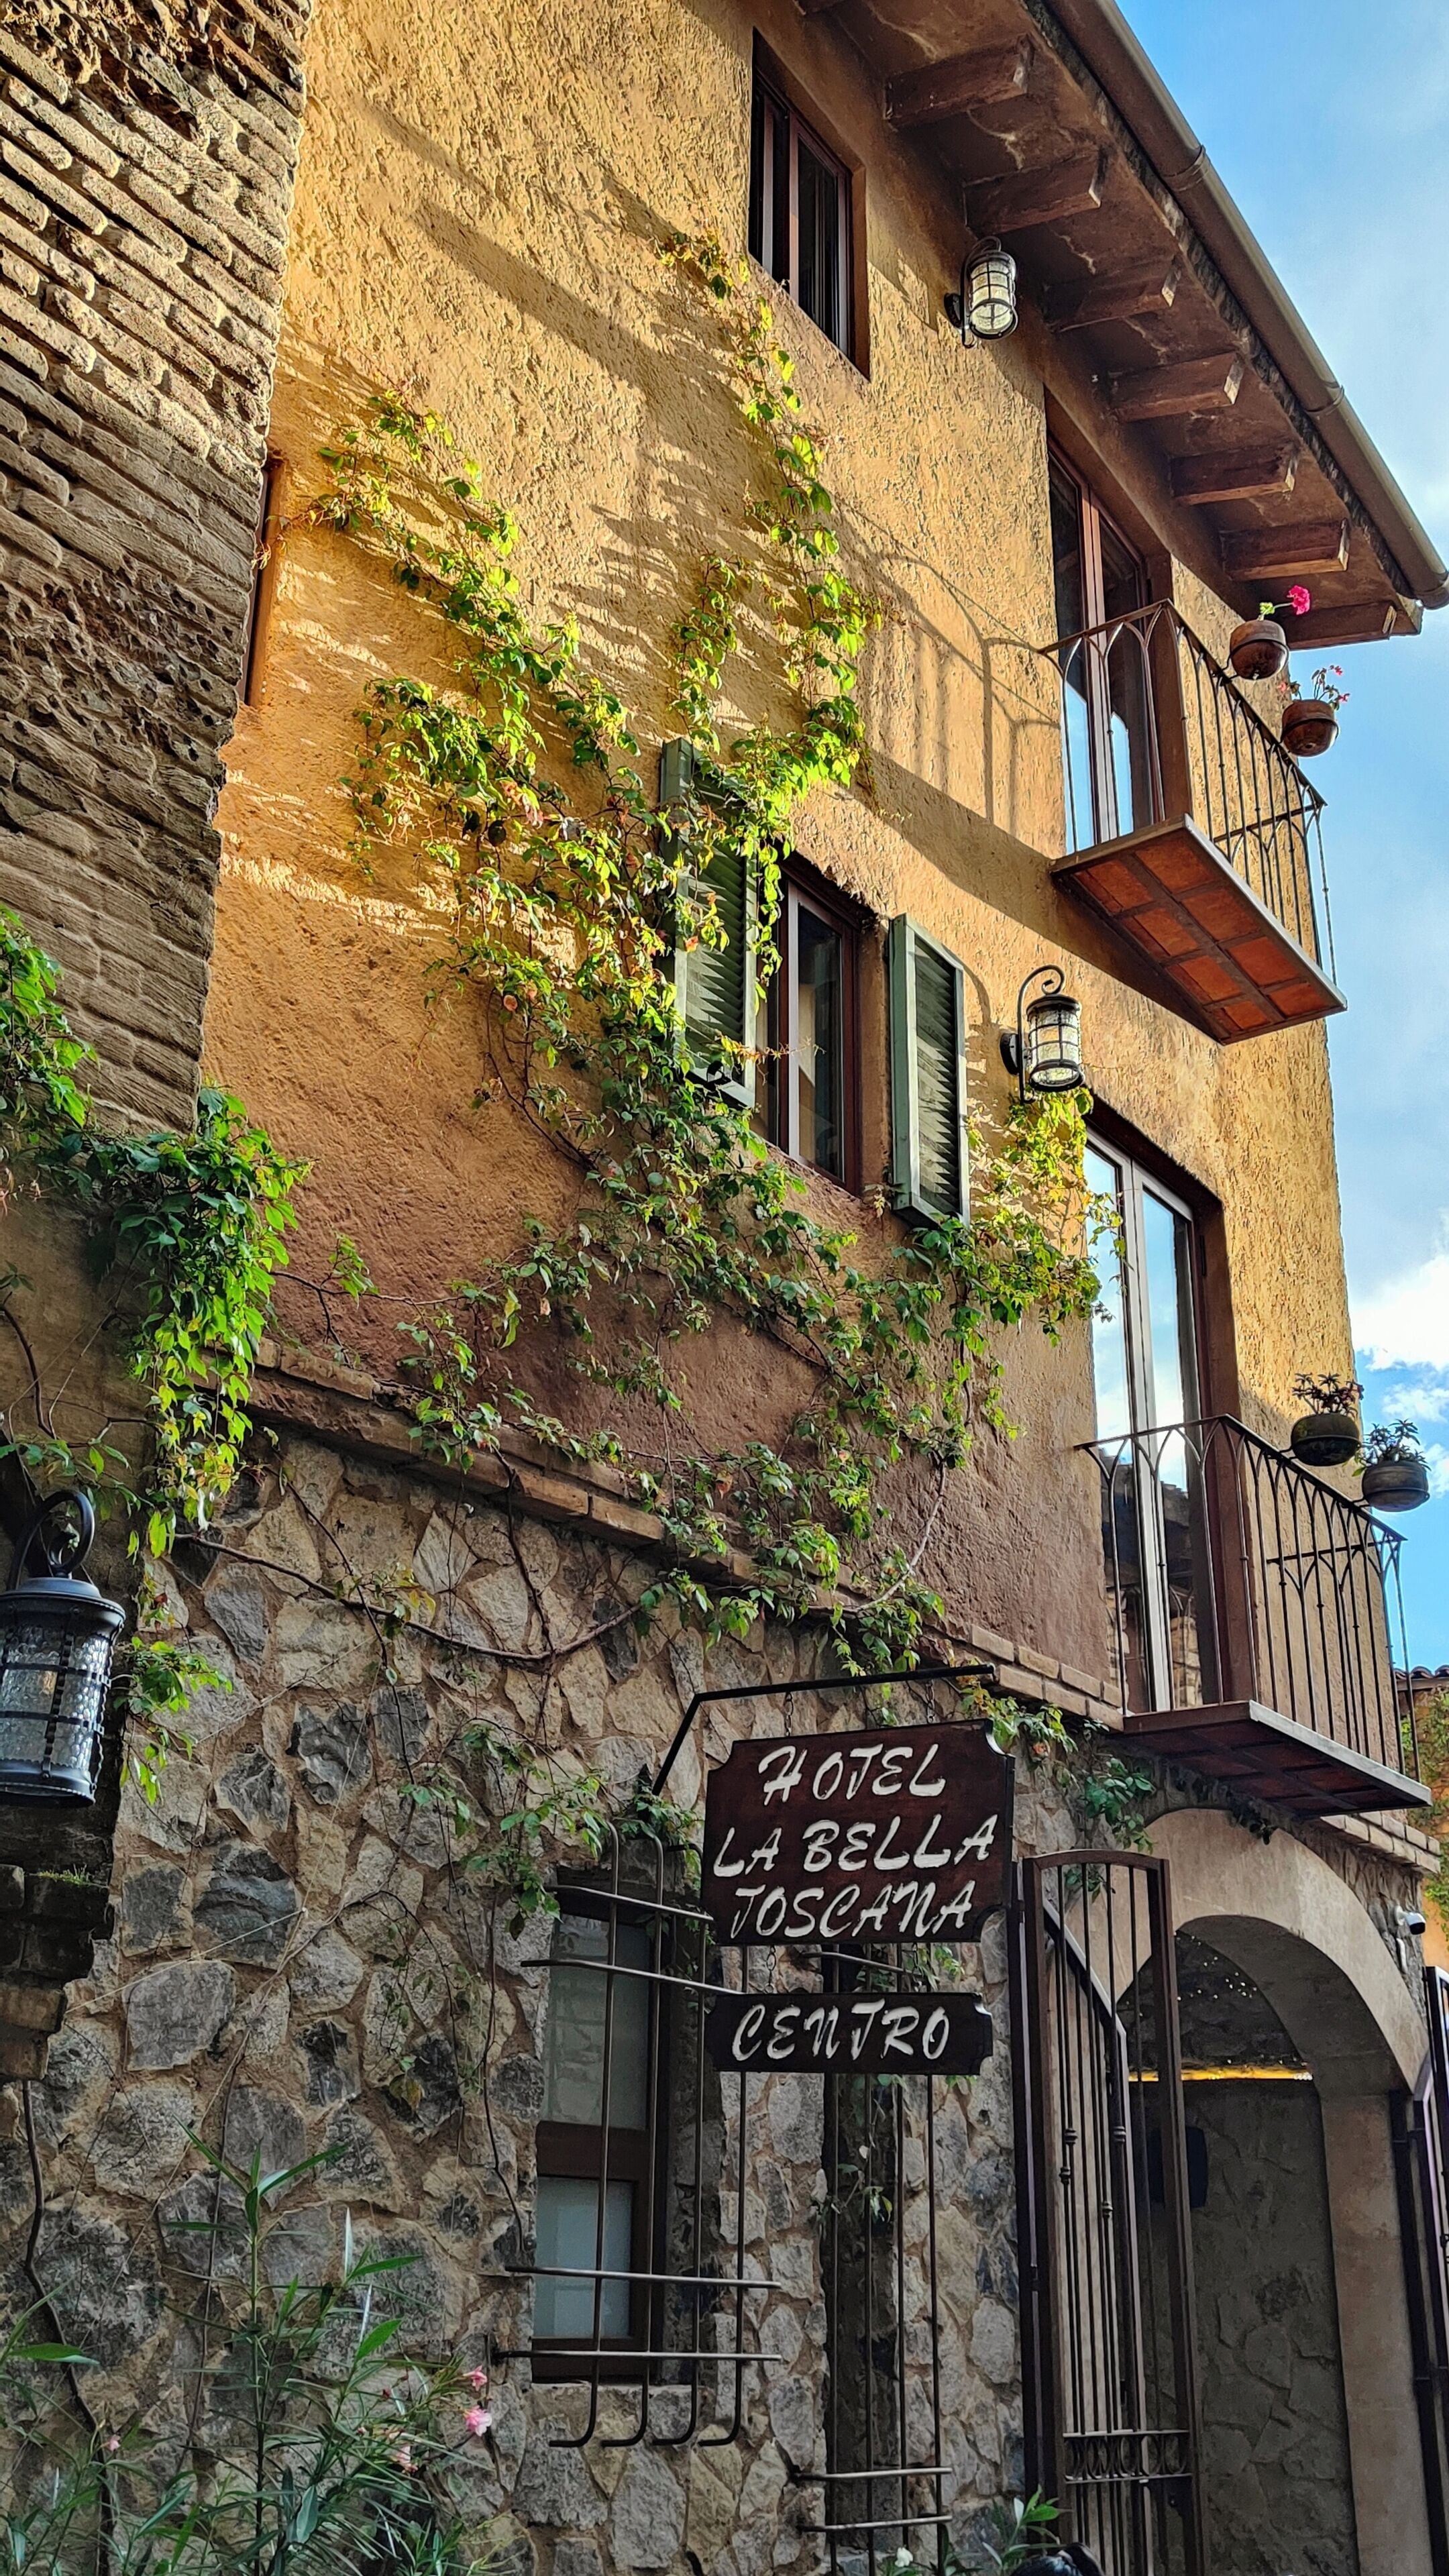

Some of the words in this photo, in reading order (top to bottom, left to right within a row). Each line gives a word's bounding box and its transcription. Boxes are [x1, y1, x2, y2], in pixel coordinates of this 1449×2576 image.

[758, 1743, 947, 1806] HOTEL
[712, 1827, 783, 1878] LA
[802, 1814, 998, 1873] BELLA
[730, 1880, 976, 1939] TOSCANA
[731, 1998, 950, 2062] CENTRO
